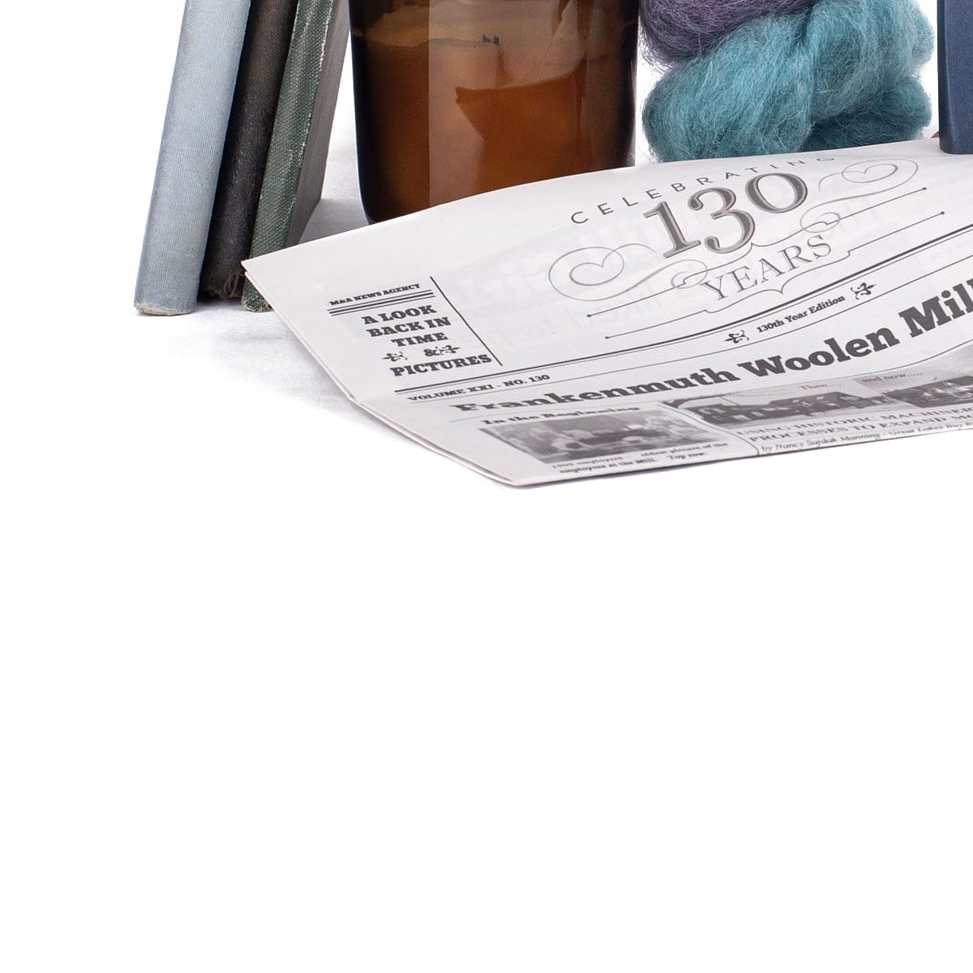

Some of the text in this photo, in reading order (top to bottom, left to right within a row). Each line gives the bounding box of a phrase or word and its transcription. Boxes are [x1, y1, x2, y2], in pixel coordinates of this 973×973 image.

[571, 156, 835, 225] CELEBRATING
[643, 172, 808, 259] 130
[700, 234, 831, 301] YEARS
[353, 290, 382, 302] NEWS
[382, 283, 421, 296] AGENCY
[361, 304, 438, 325] A LOOK
[756, 294, 846, 334] 130th Year Edition
[366, 316, 452, 338] BACK IN
[391, 331, 448, 347] TIME
[389, 353, 492, 377] PICTURES
[453, 367, 741, 412] Frankenmuth
[737, 327, 900, 377] Woolen
[407, 388, 467, 402] VOLUME
[466, 384, 494, 395] XXI
[504, 378, 528, 389] NO.
[529, 374, 551, 383] 130
[862, 375, 882, 383] and
[541, 406, 641, 419] Beginning
[736, 425, 792, 436] USING
[794, 416, 876, 429] HISTORIC
[748, 427, 849, 442] PROCESSES
[849, 423, 876, 432] TO
[879, 417, 949, 432] EXPAND
